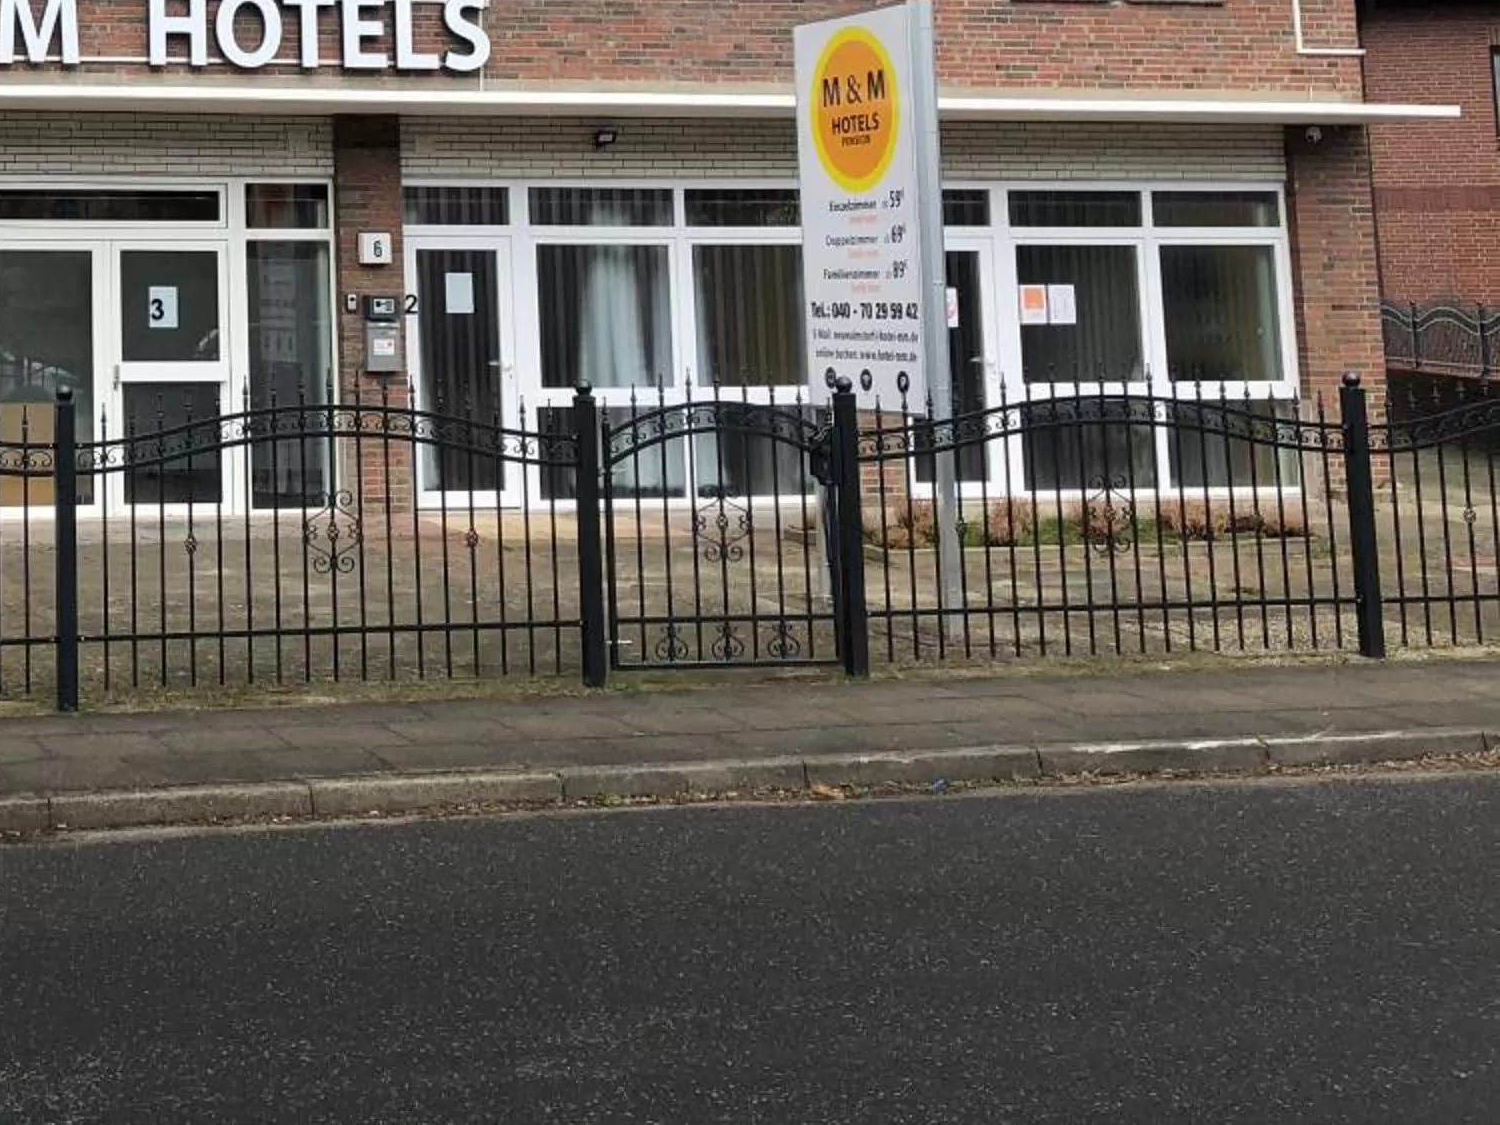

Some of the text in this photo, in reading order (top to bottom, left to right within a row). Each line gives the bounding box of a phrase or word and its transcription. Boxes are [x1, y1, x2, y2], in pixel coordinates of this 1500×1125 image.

[823, 70, 885, 108] M & M
[831, 112, 880, 136] HOTELS
[373, 240, 383, 258] 6
[151, 298, 165, 321] 3
[405, 294, 419, 314] 2
[831, 301, 851, 319] 040
[860, 302, 873, 320] 70
[905, 302, 918, 320] 42
